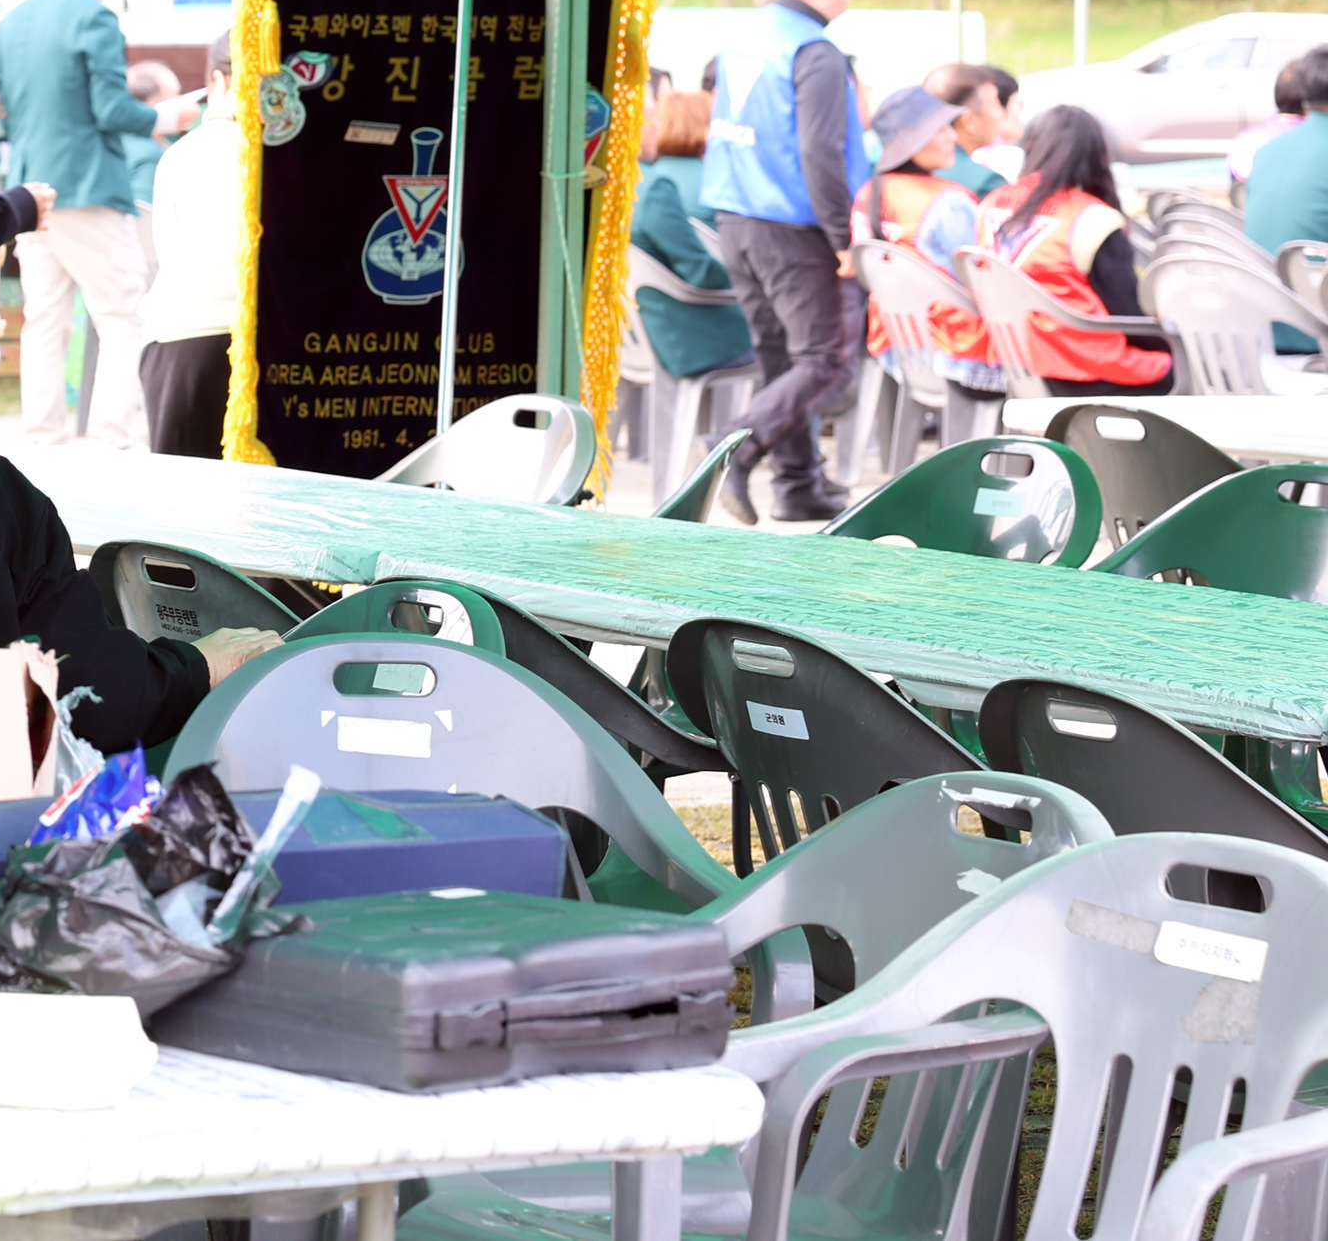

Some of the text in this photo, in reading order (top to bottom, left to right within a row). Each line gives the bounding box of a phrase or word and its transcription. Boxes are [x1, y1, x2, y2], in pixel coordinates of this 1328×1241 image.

[288, 14, 412, 44] 국제와이즈멘
[421, 14, 498, 44] 한국역
[304, 331, 419, 353] GANGJIN
[266, 362, 315, 385] OREA
[319, 363, 374, 386] AREA
[476, 363, 538, 385] REGIO
[314, 397, 357, 419] MEN
[395, 428, 415, 449] 4.
